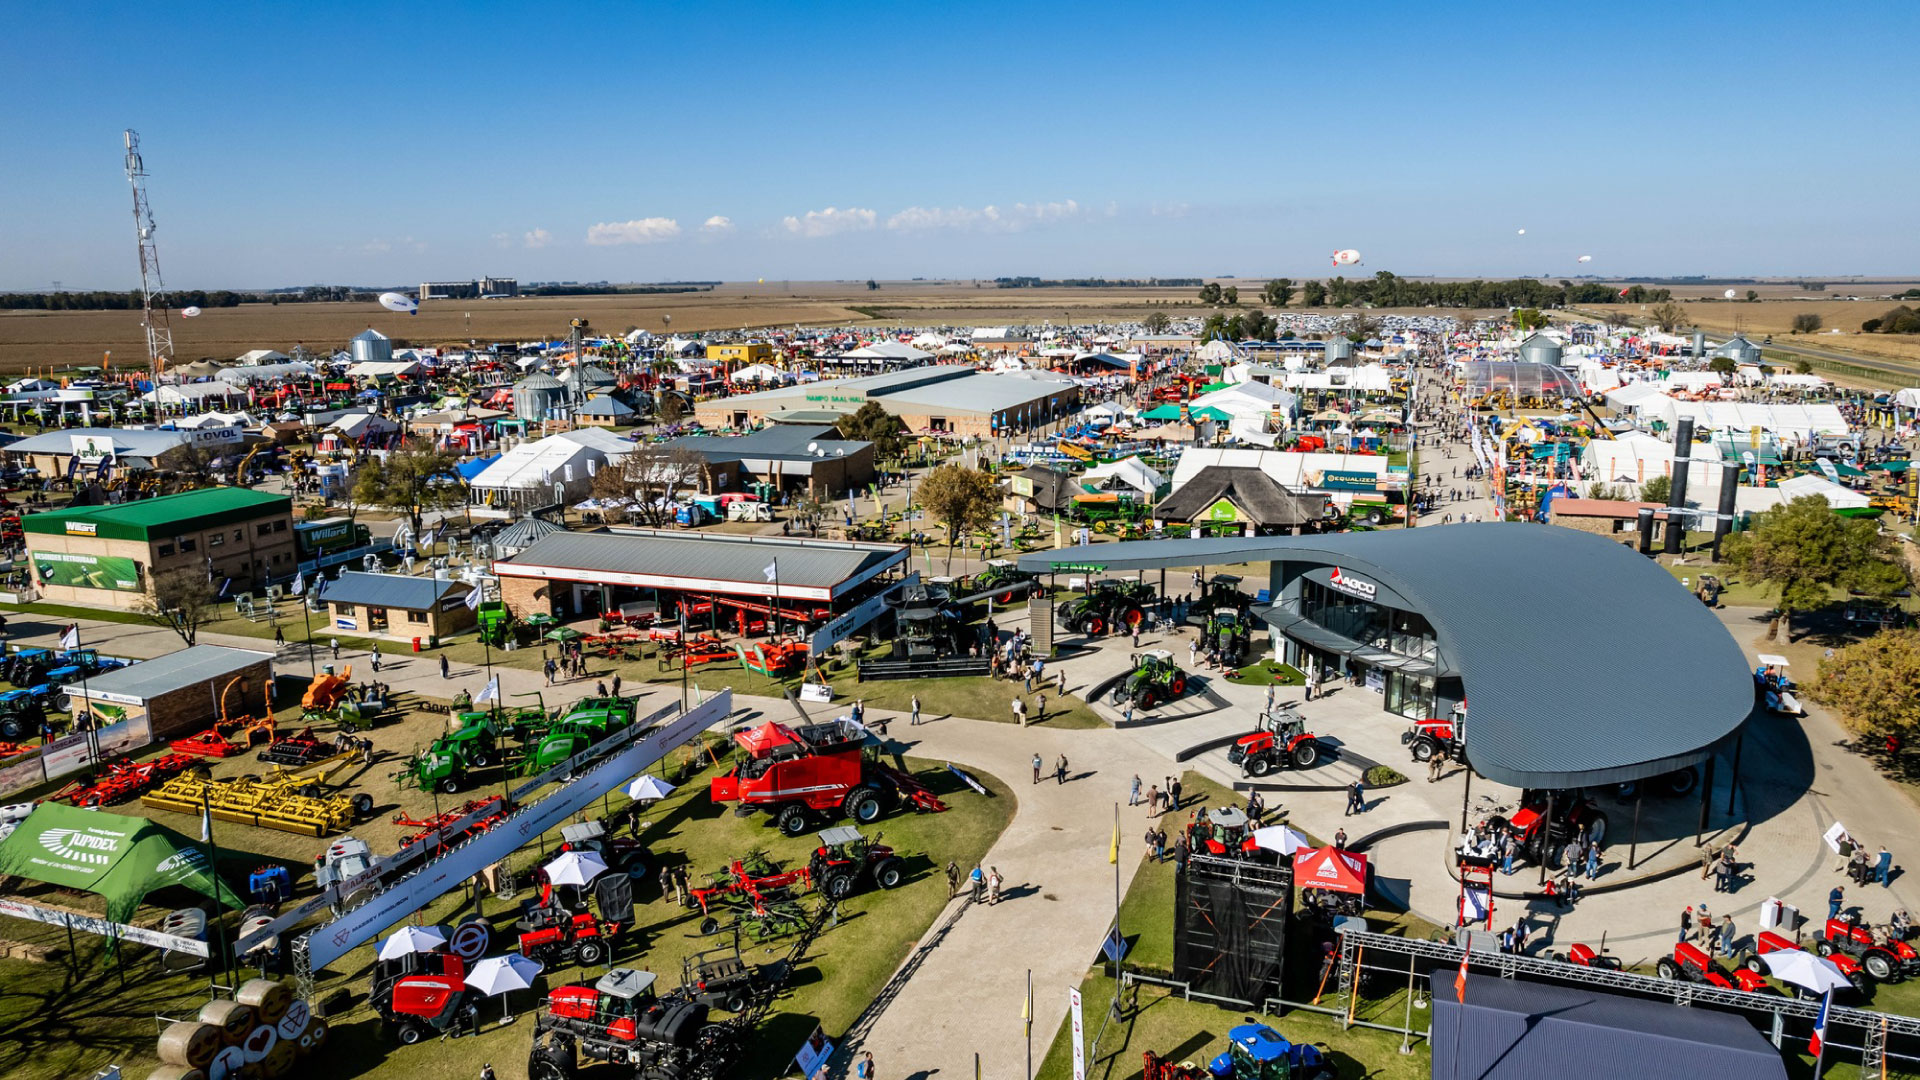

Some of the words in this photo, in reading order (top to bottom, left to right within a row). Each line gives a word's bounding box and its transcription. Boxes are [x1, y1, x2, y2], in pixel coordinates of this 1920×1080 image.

[197, 429, 238, 442] LOVOL
[65, 521, 97, 531] Willard
[312, 525, 347, 541] Willard
[1342, 577, 1376, 594] AGCO
[350, 866, 382, 888] ALPLER
